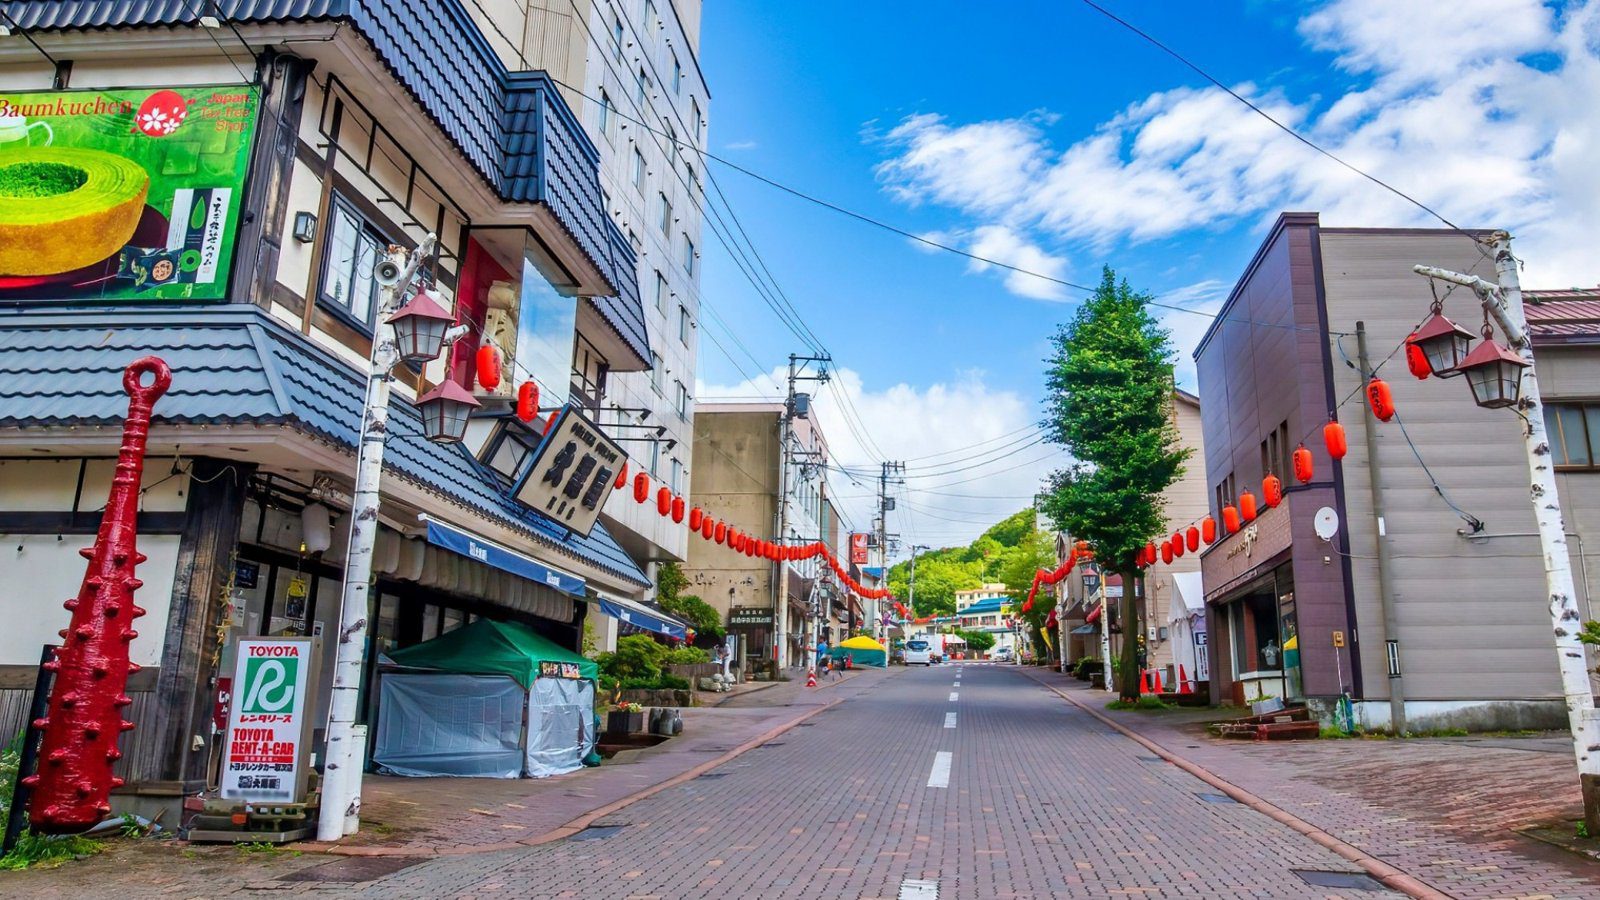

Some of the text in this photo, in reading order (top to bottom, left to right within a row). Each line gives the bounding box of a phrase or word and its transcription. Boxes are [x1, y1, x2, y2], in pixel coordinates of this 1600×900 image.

[0, 96, 132, 118] Baumkuchen
[249, 646, 299, 657] TOYOTA
[240, 714, 292, 723] レンタリース
[233, 728, 274, 742] TOYOTA
[231, 742, 294, 755] RENT-A-CAR
